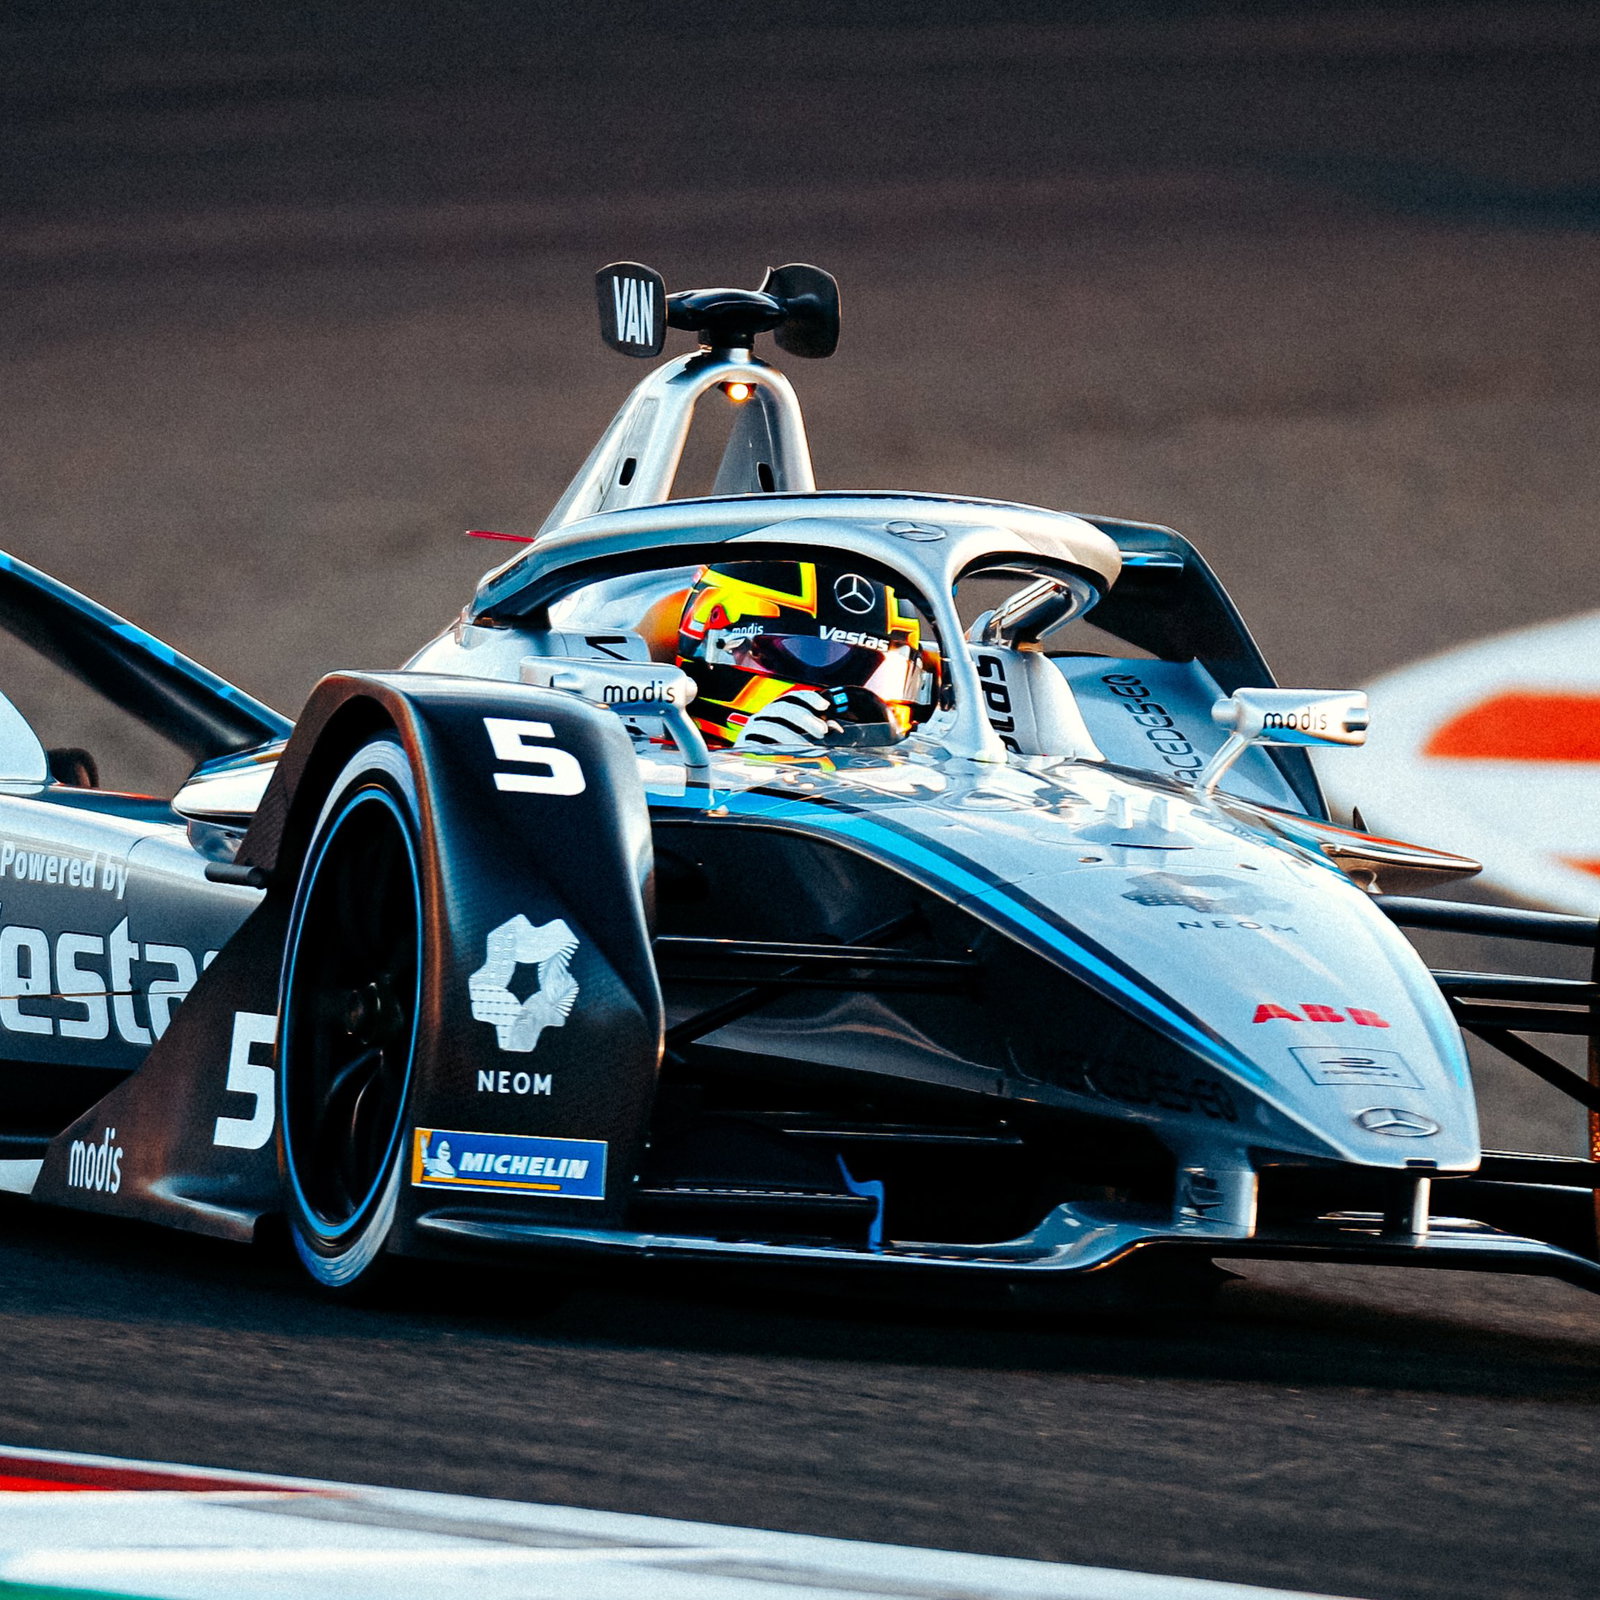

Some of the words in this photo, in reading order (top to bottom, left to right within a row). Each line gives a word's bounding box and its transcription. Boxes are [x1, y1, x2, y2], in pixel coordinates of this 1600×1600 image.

[612, 275, 654, 346] VAN
[732, 623, 764, 635] modis
[819, 625, 890, 652] Vestas
[603, 681, 676, 703] modis
[1101, 674, 1205, 781] RCEDES-EQ
[1263, 706, 1328, 731] modis
[484, 718, 587, 796] 5
[1, 841, 96, 889] Powered
[103, 854, 130, 899] by
[1177, 920, 1299, 934] NEOM
[0, 905, 221, 1044] esta
[1252, 1003, 1391, 1028] ABB
[213, 1011, 278, 1149] 5
[477, 1070, 552, 1096] NEOM
[68, 1127, 124, 1194] modis
[459, 1152, 590, 1179] MICHELIN
